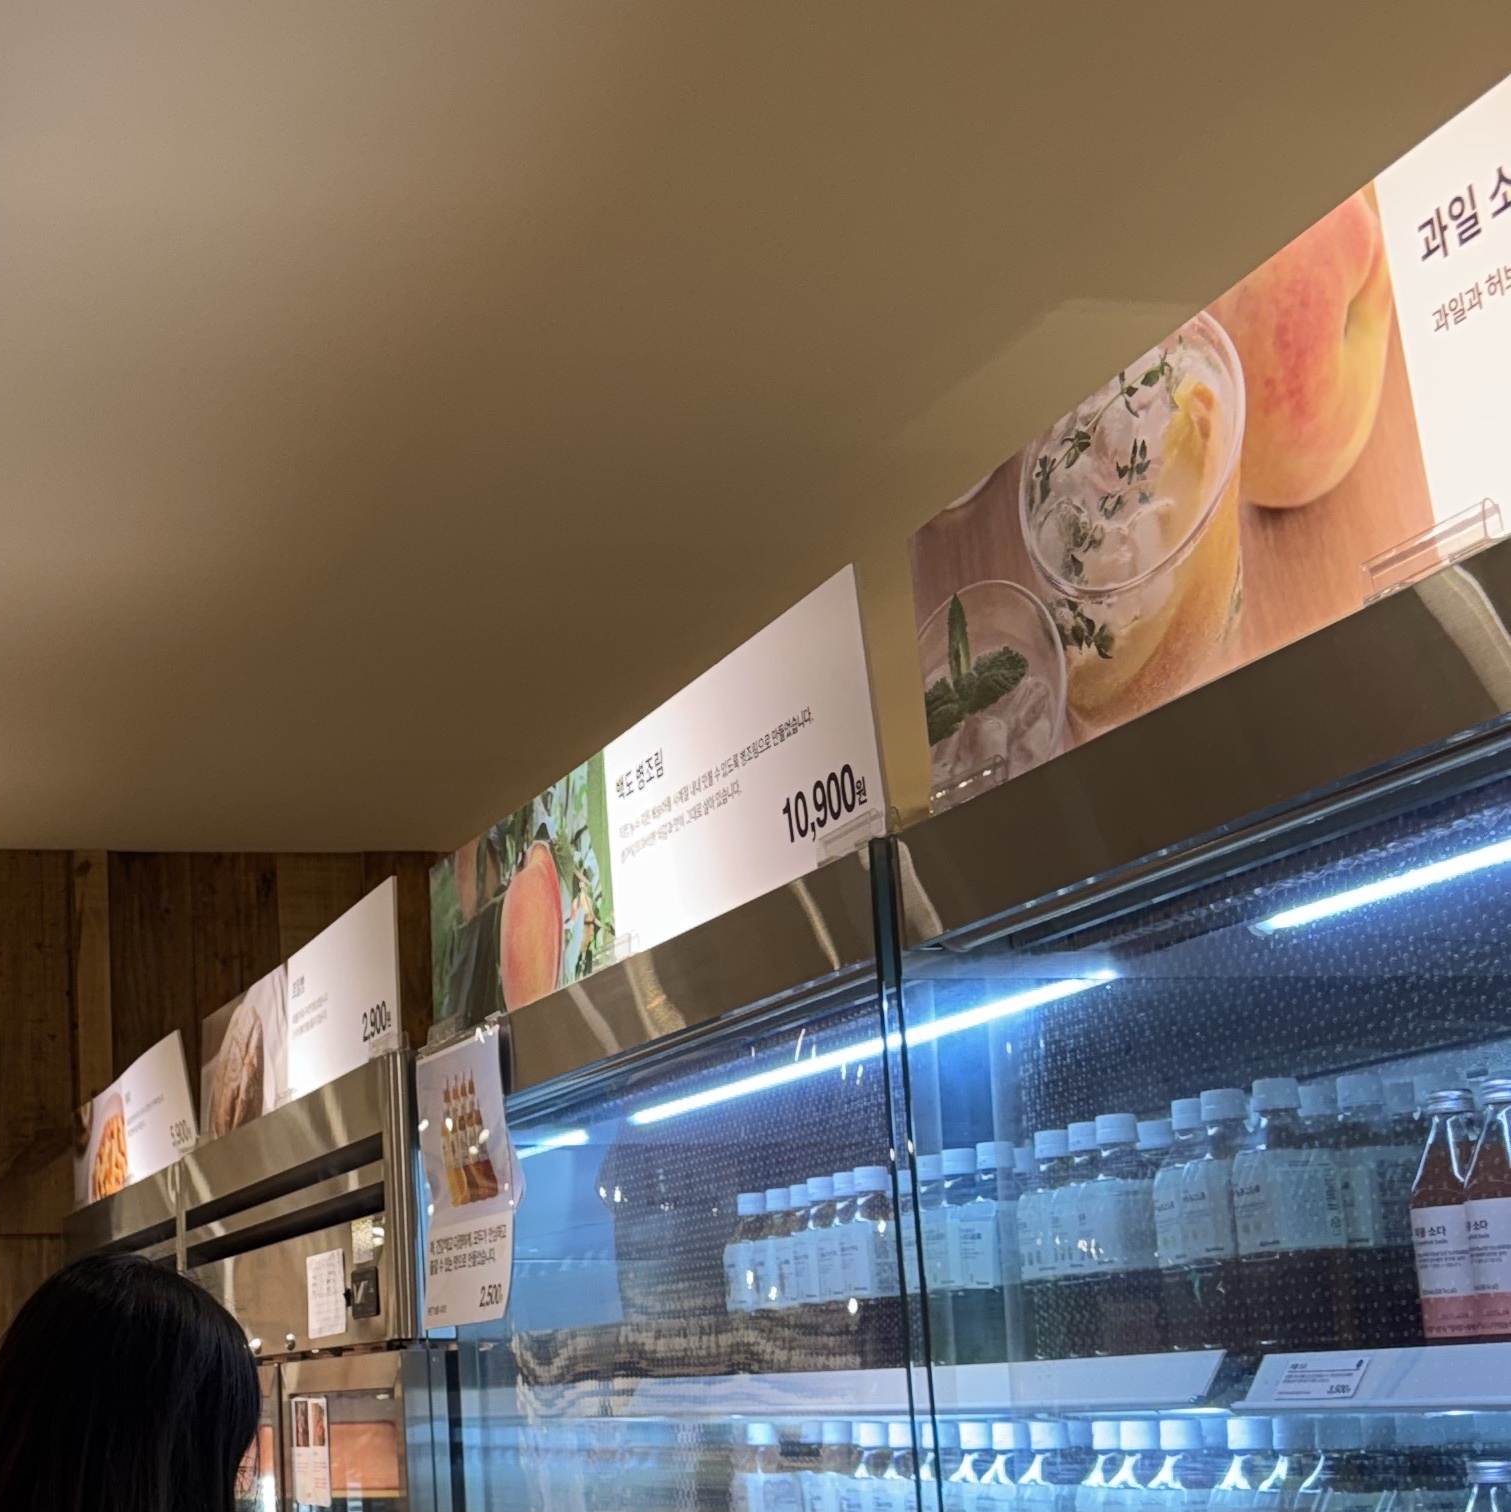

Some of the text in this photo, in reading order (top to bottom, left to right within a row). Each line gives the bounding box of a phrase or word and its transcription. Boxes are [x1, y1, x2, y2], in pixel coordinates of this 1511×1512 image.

[1417, 184, 1482, 262] 과일
[1432, 282, 1484, 333] 과일과
[782, 763, 868, 844] 10,900원
[1428, 1225, 1446, 1237] 소다
[1472, 1220, 1489, 1231] 소다
